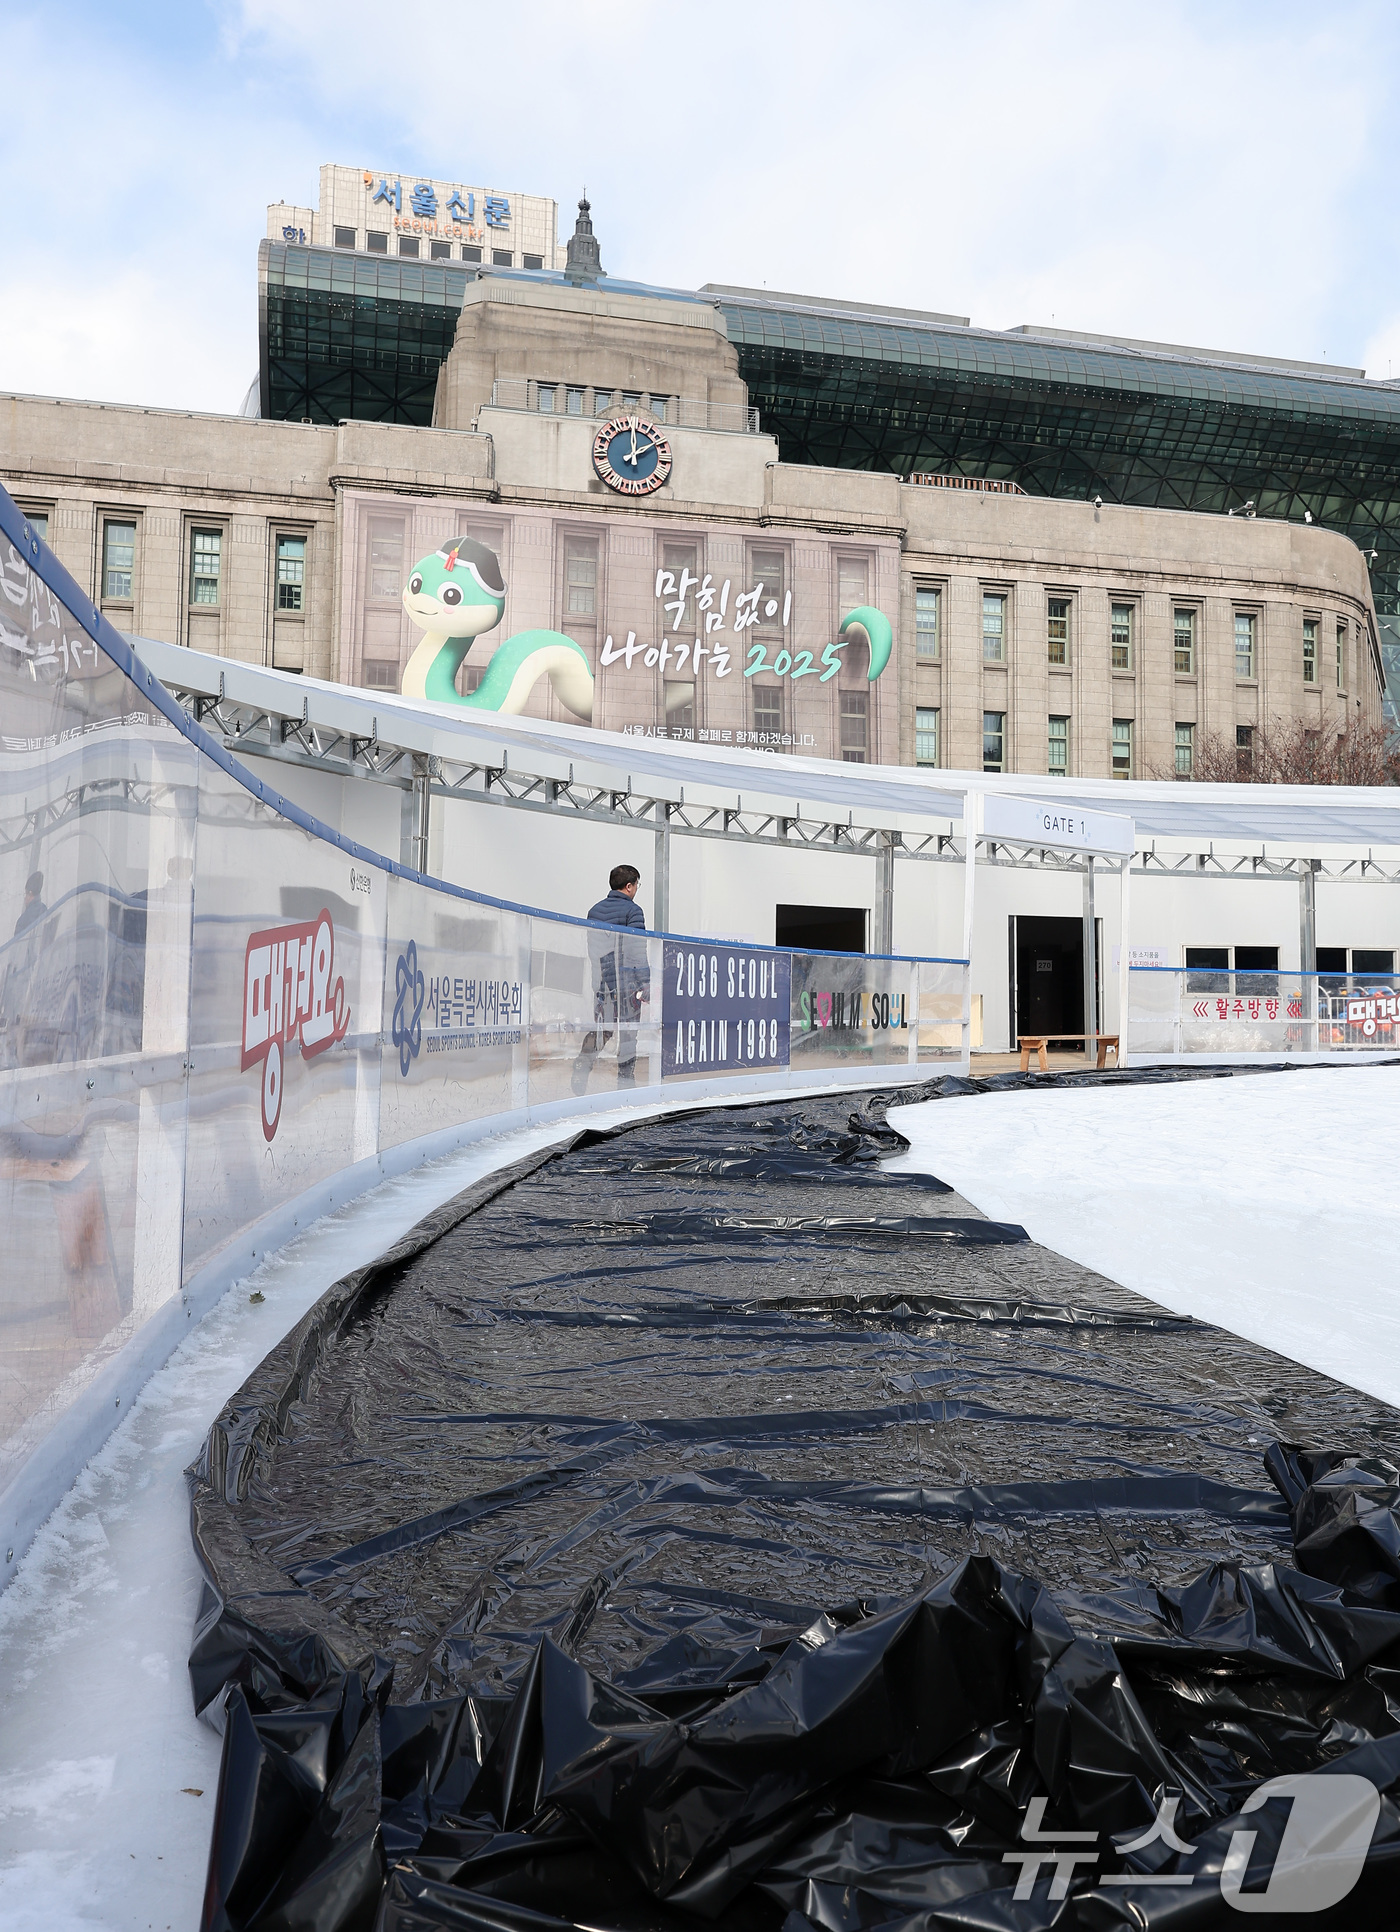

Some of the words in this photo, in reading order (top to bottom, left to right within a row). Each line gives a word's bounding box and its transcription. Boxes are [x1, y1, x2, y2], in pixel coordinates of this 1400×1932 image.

[372, 179, 511, 227] 서울신문
[393, 216, 483, 239] seoul.co.kr
[655, 567, 792, 634] 막힘없이
[600, 630, 732, 678] 나아가는
[744, 642, 849, 682] 2025
[622, 724, 668, 740] 서울시도
[671, 727, 695, 741] 규제
[698, 729, 732, 742] 철폐로
[736, 730, 818, 747] 함께하겠습니다.
[1043, 815, 1073, 833] GATE
[1080, 820, 1085, 835] 1
[676, 952, 718, 998] 2036
[727, 956, 778, 999] SEOUL
[242, 914, 345, 1134] 땡겨요
[427, 976, 522, 1028] 서울특별시체육회
[871, 992, 908, 1030] SOUL
[1215, 998, 1280, 1020] 활주방향
[675, 1019, 728, 1065] AGAIN
[736, 1018, 778, 1060] 1988
